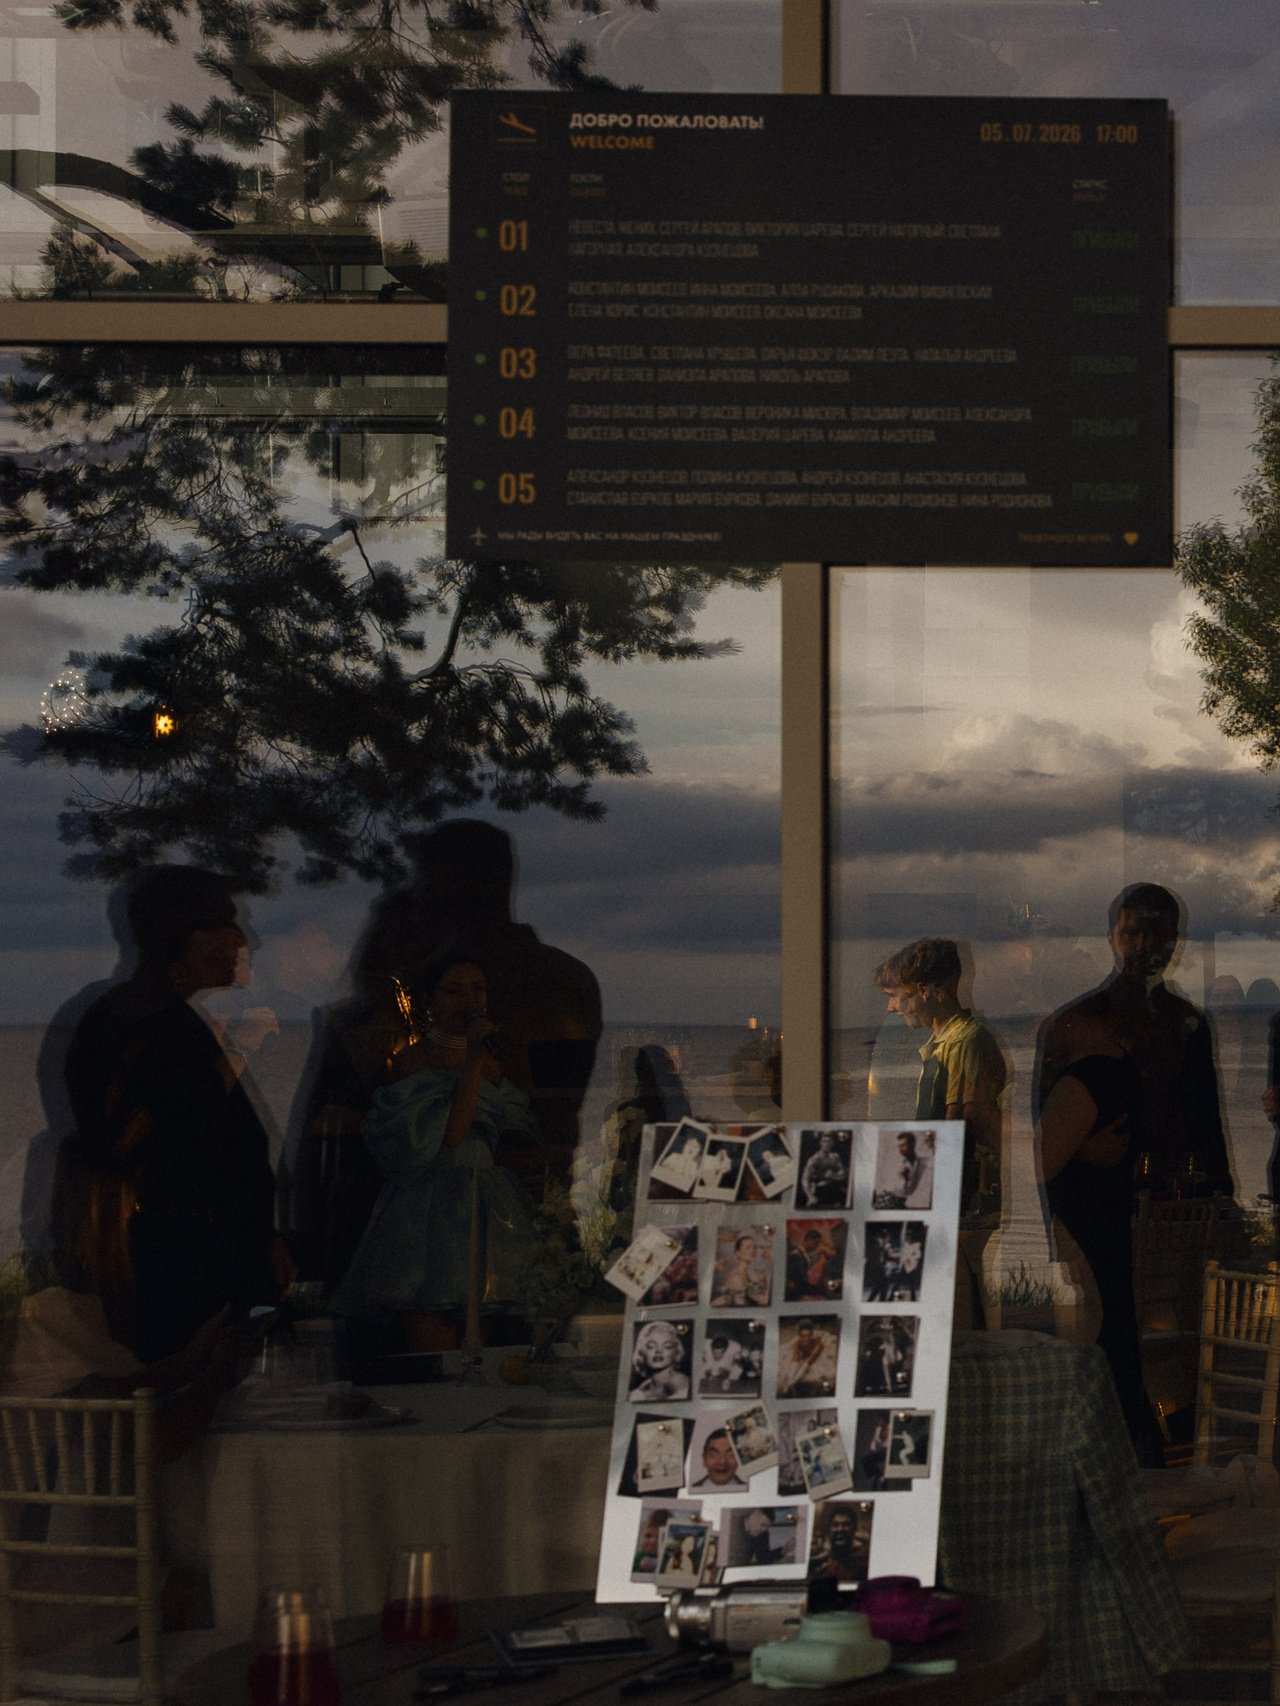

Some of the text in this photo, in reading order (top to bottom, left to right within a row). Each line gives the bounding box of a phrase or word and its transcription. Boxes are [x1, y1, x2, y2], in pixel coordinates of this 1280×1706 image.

[569, 112, 764, 131] ДОБРО ПОЖАЛОВАТЬ!
[1097, 124, 1137, 144] 17:00
[569, 135, 654, 151] WELCOME
[498, 220, 529, 253] 01
[500, 285, 537, 316] 02
[499, 348, 537, 379] 03
[498, 407, 537, 440] 04
[498, 472, 536, 505] 05
